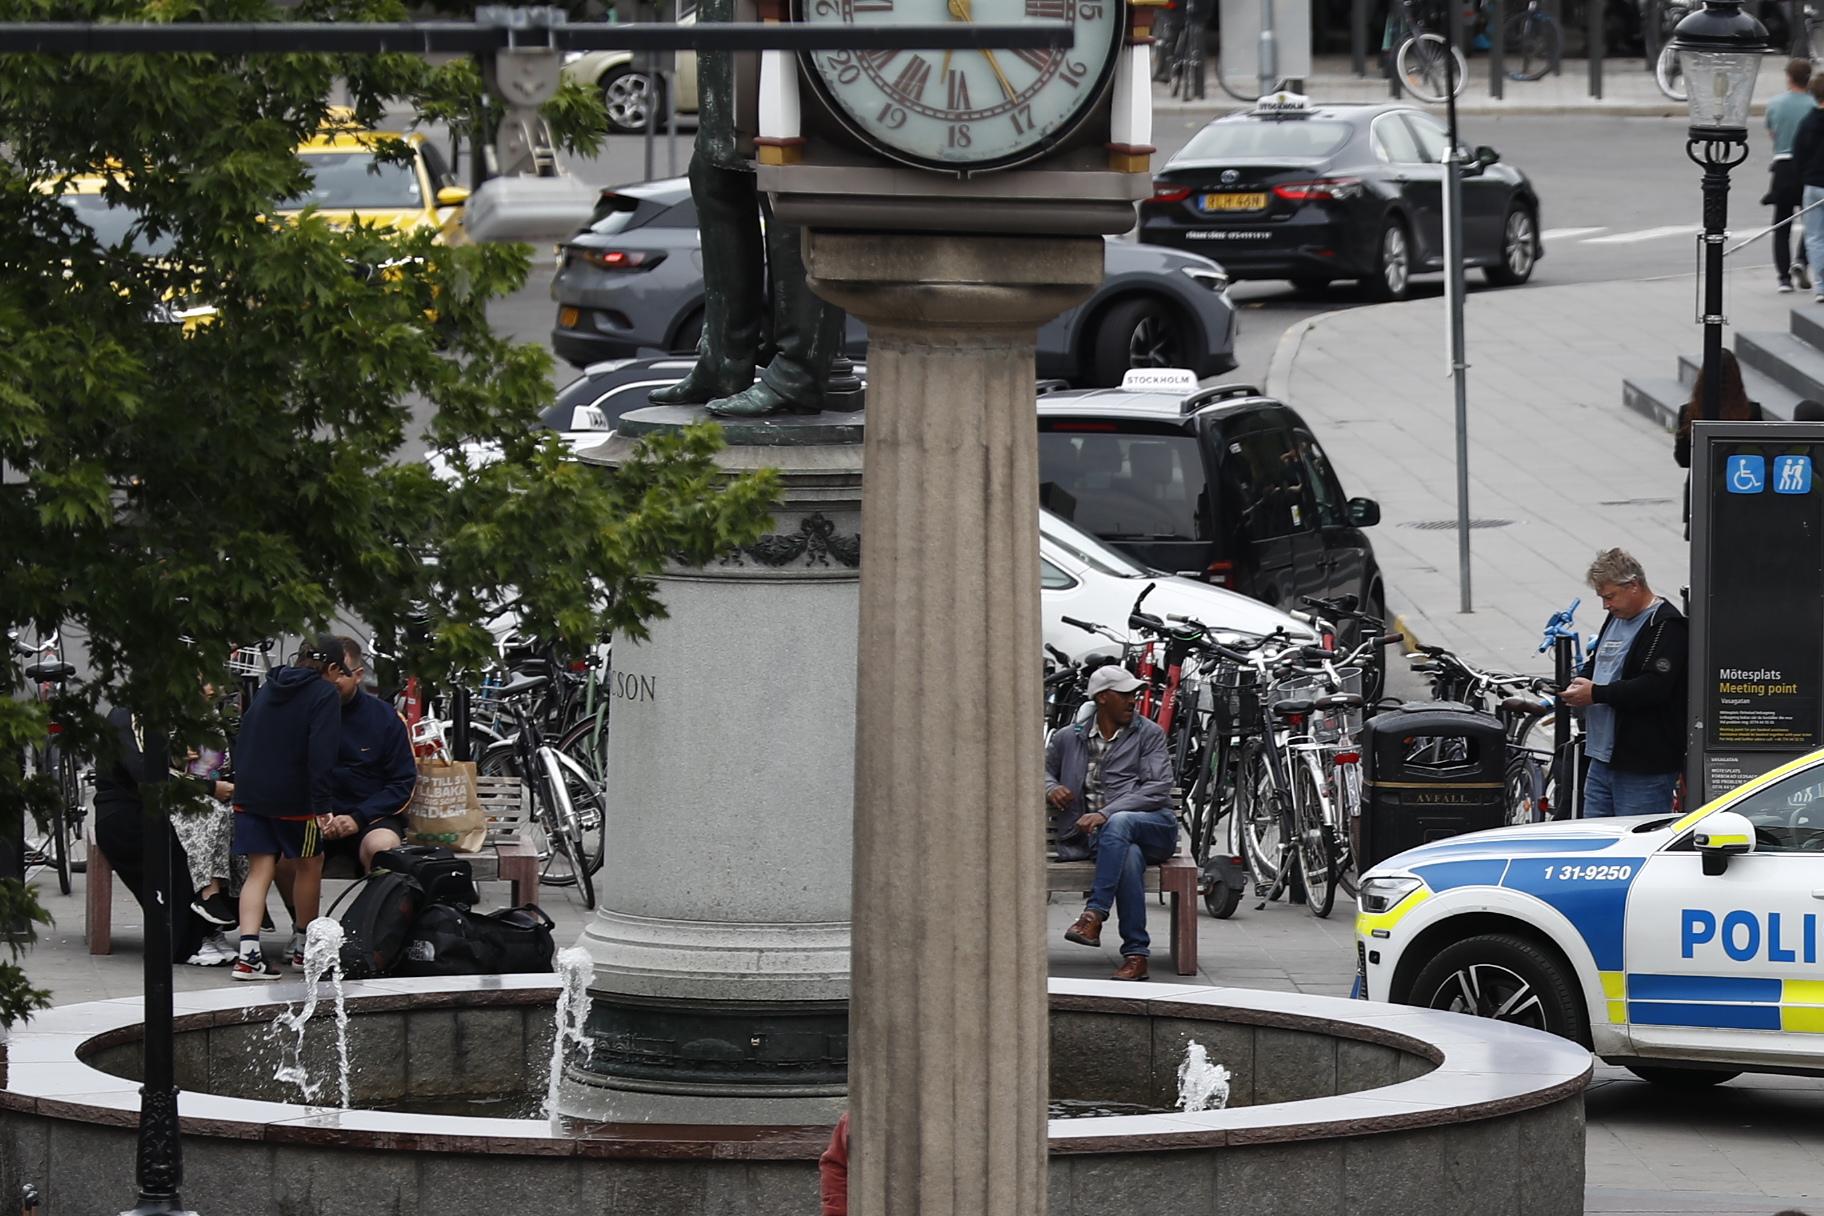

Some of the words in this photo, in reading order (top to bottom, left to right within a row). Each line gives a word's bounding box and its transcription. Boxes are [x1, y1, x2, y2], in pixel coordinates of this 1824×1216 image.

[1059, 60, 1089, 89] 16
[876, 102, 908, 129] 19
[1008, 103, 1037, 136] 17
[947, 123, 972, 148] 18
[1127, 376, 1190, 384] STOCKHOLM
[1719, 668, 1781, 682] Mötesplats
[1719, 682, 1765, 696] Meeting
[1768, 682, 1798, 696] point
[1415, 794, 1470, 803] AVFALL
[1544, 866, 1554, 880] 1
[1558, 865, 1632, 881] 31-9250
